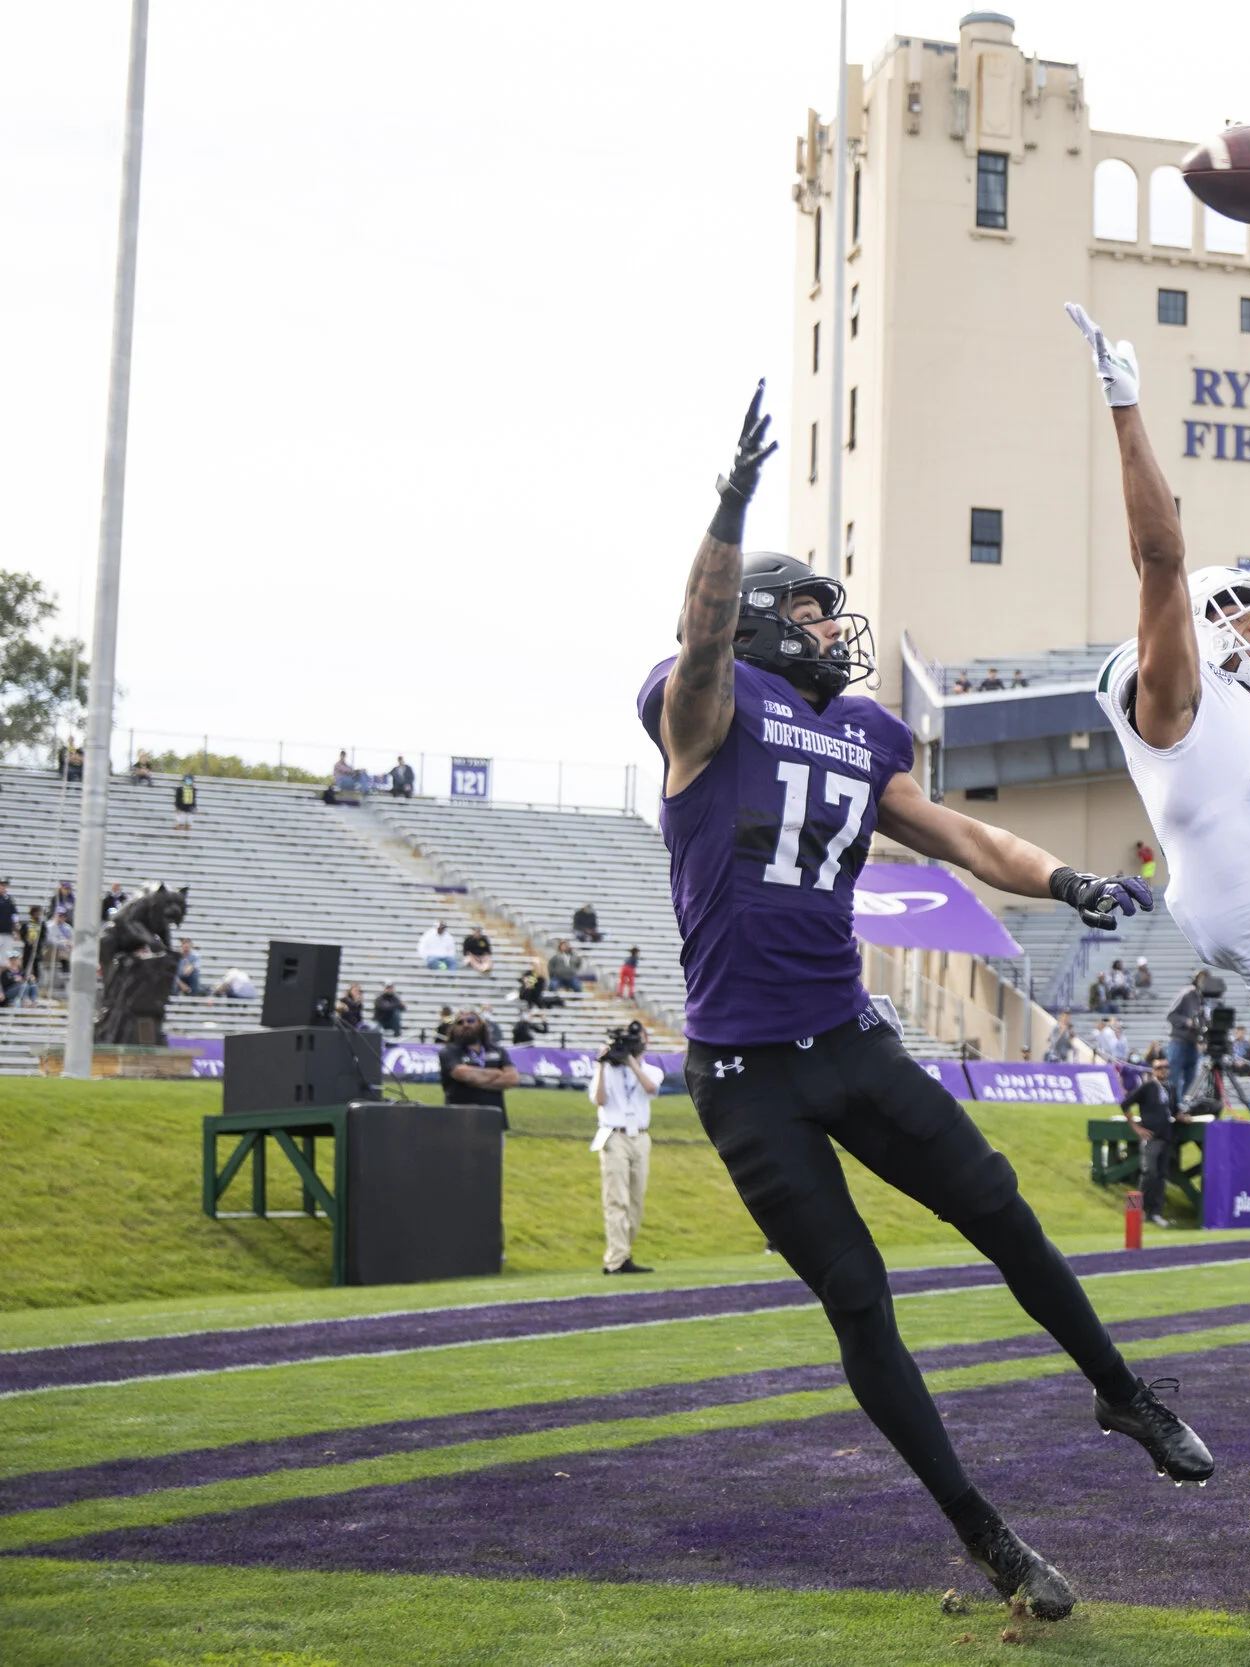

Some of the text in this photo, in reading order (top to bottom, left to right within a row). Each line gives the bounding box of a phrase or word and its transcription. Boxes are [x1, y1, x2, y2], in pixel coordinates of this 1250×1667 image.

[763, 718, 872, 772] NORTHWESTERN
[455, 770, 485, 796] 121
[763, 760, 871, 892] 17
[994, 1073, 1073, 1089] UNITED
[982, 1085, 1077, 1104] AIRLINES
